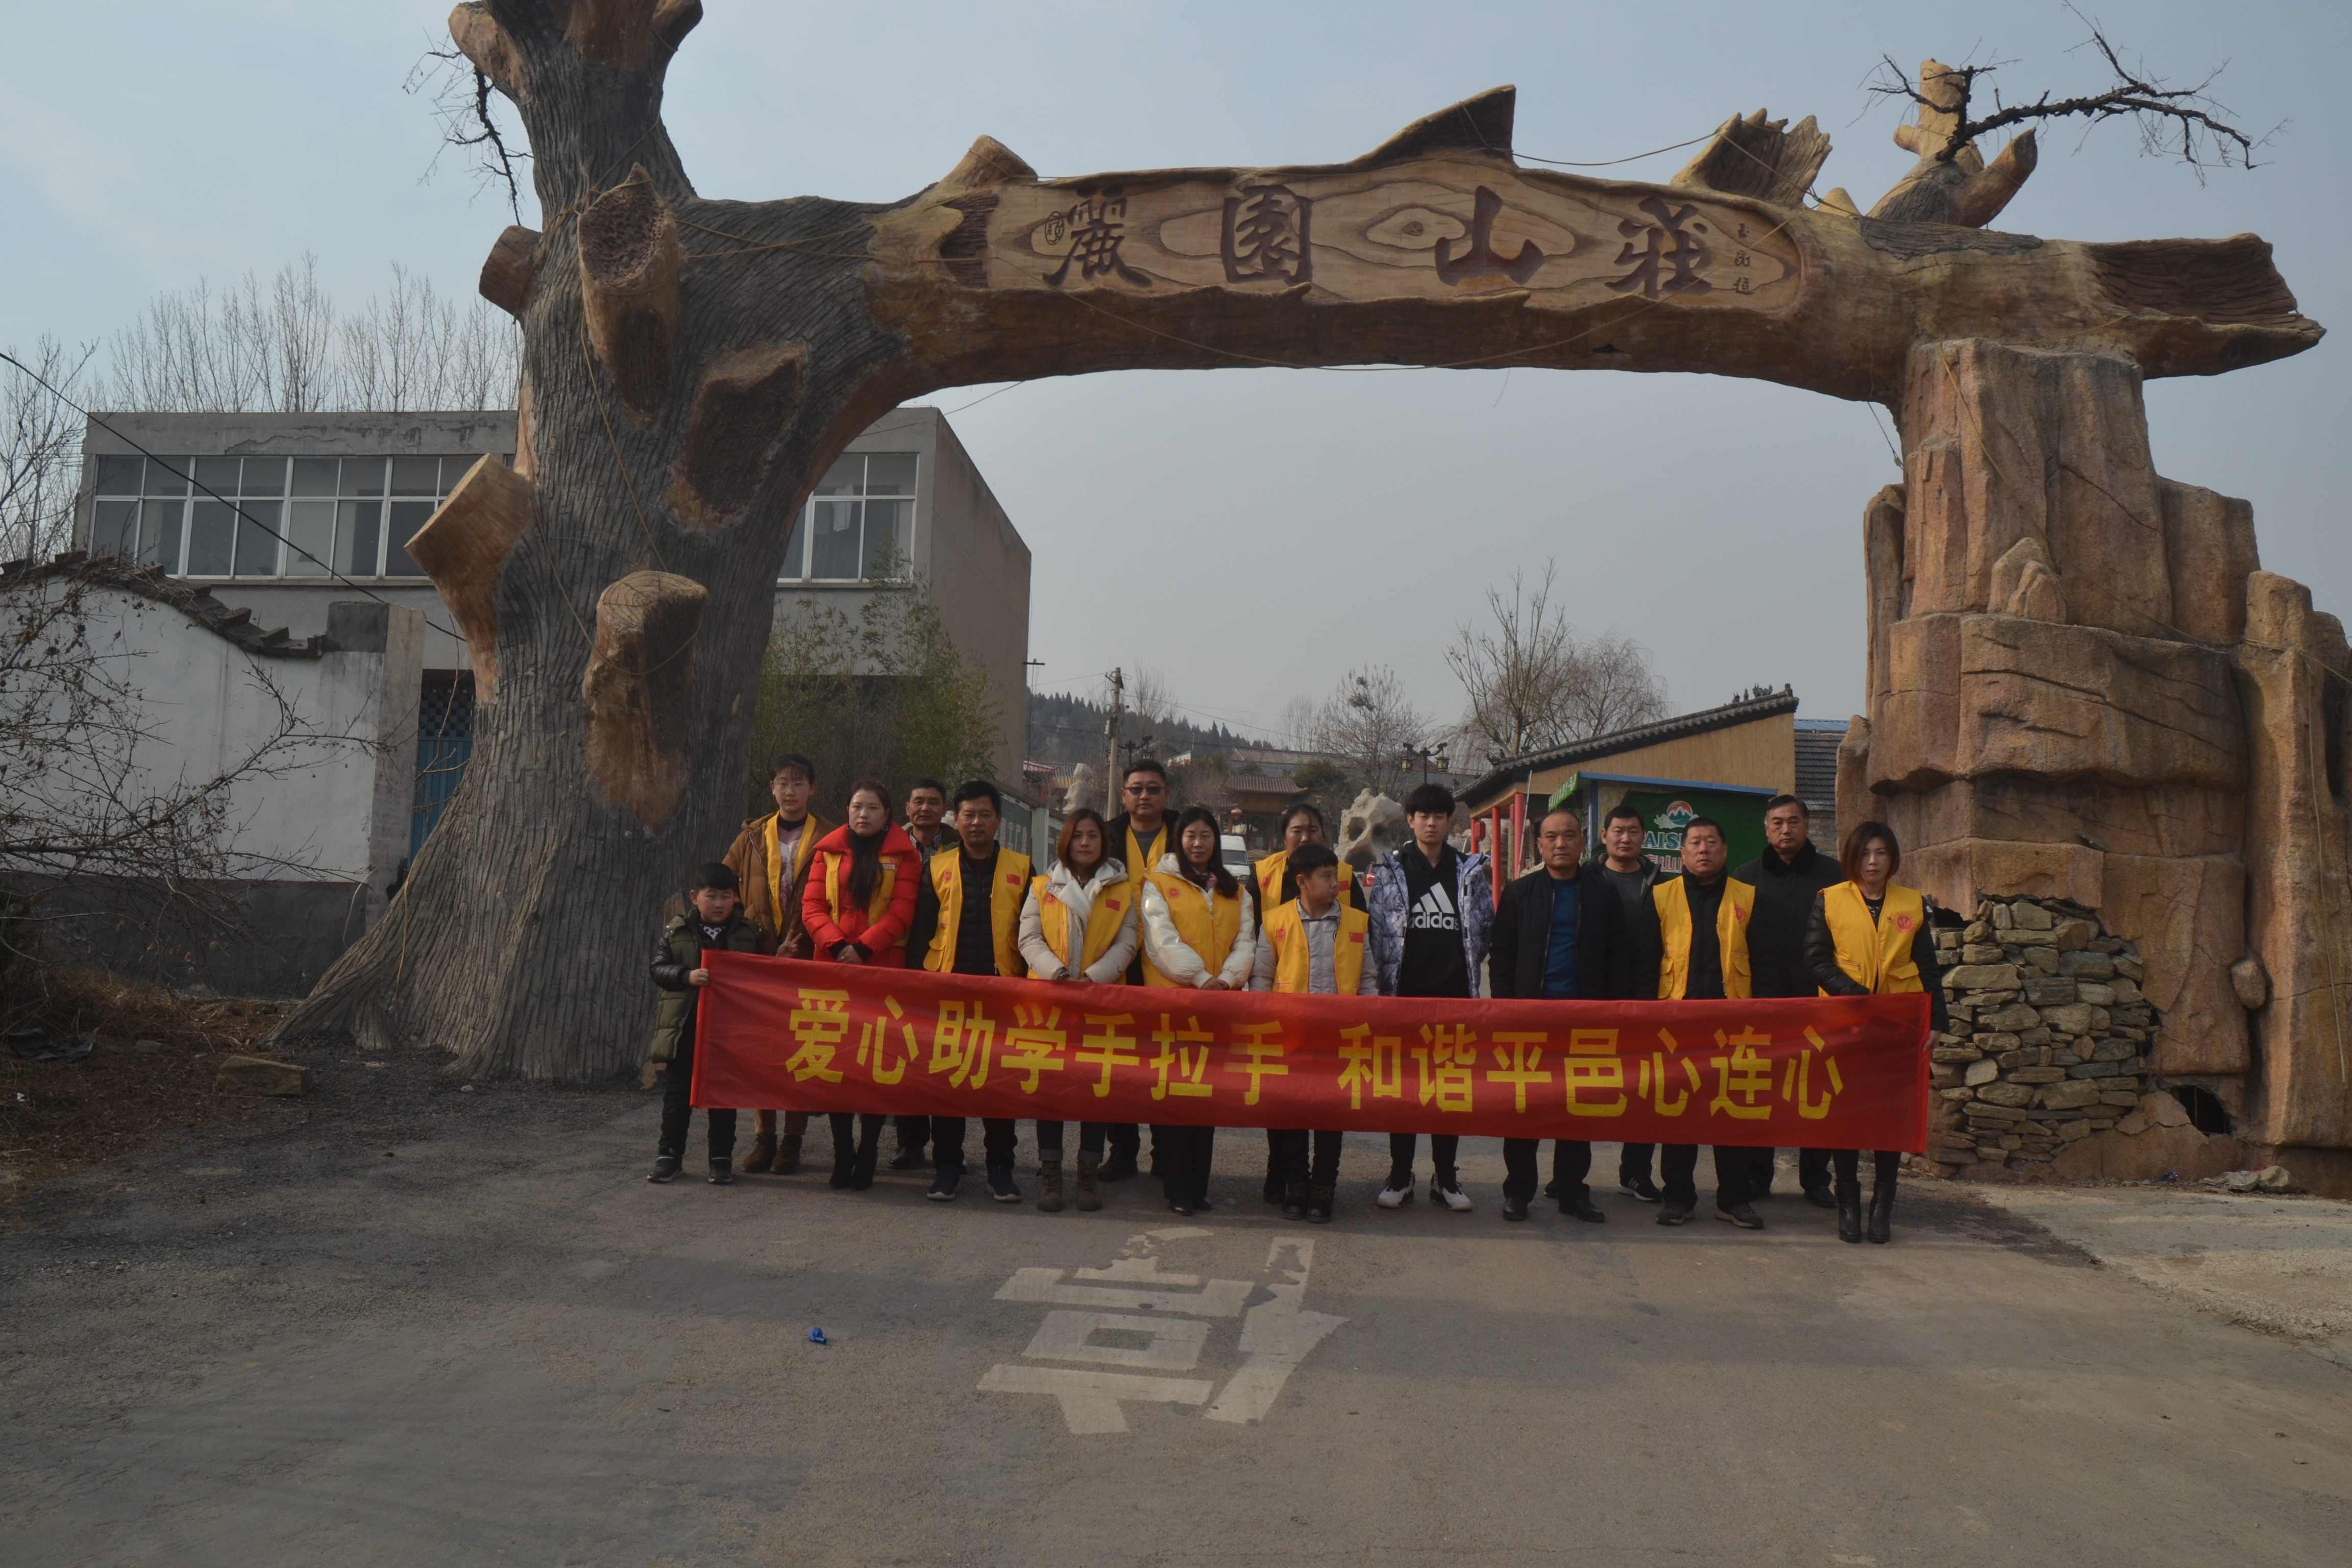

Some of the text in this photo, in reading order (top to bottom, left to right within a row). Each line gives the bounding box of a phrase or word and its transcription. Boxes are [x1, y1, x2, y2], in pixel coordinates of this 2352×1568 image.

[1409, 912, 1459, 930] adidas
[786, 988, 1843, 1120] 爱心助学手拉手 和谐平邑心连心
